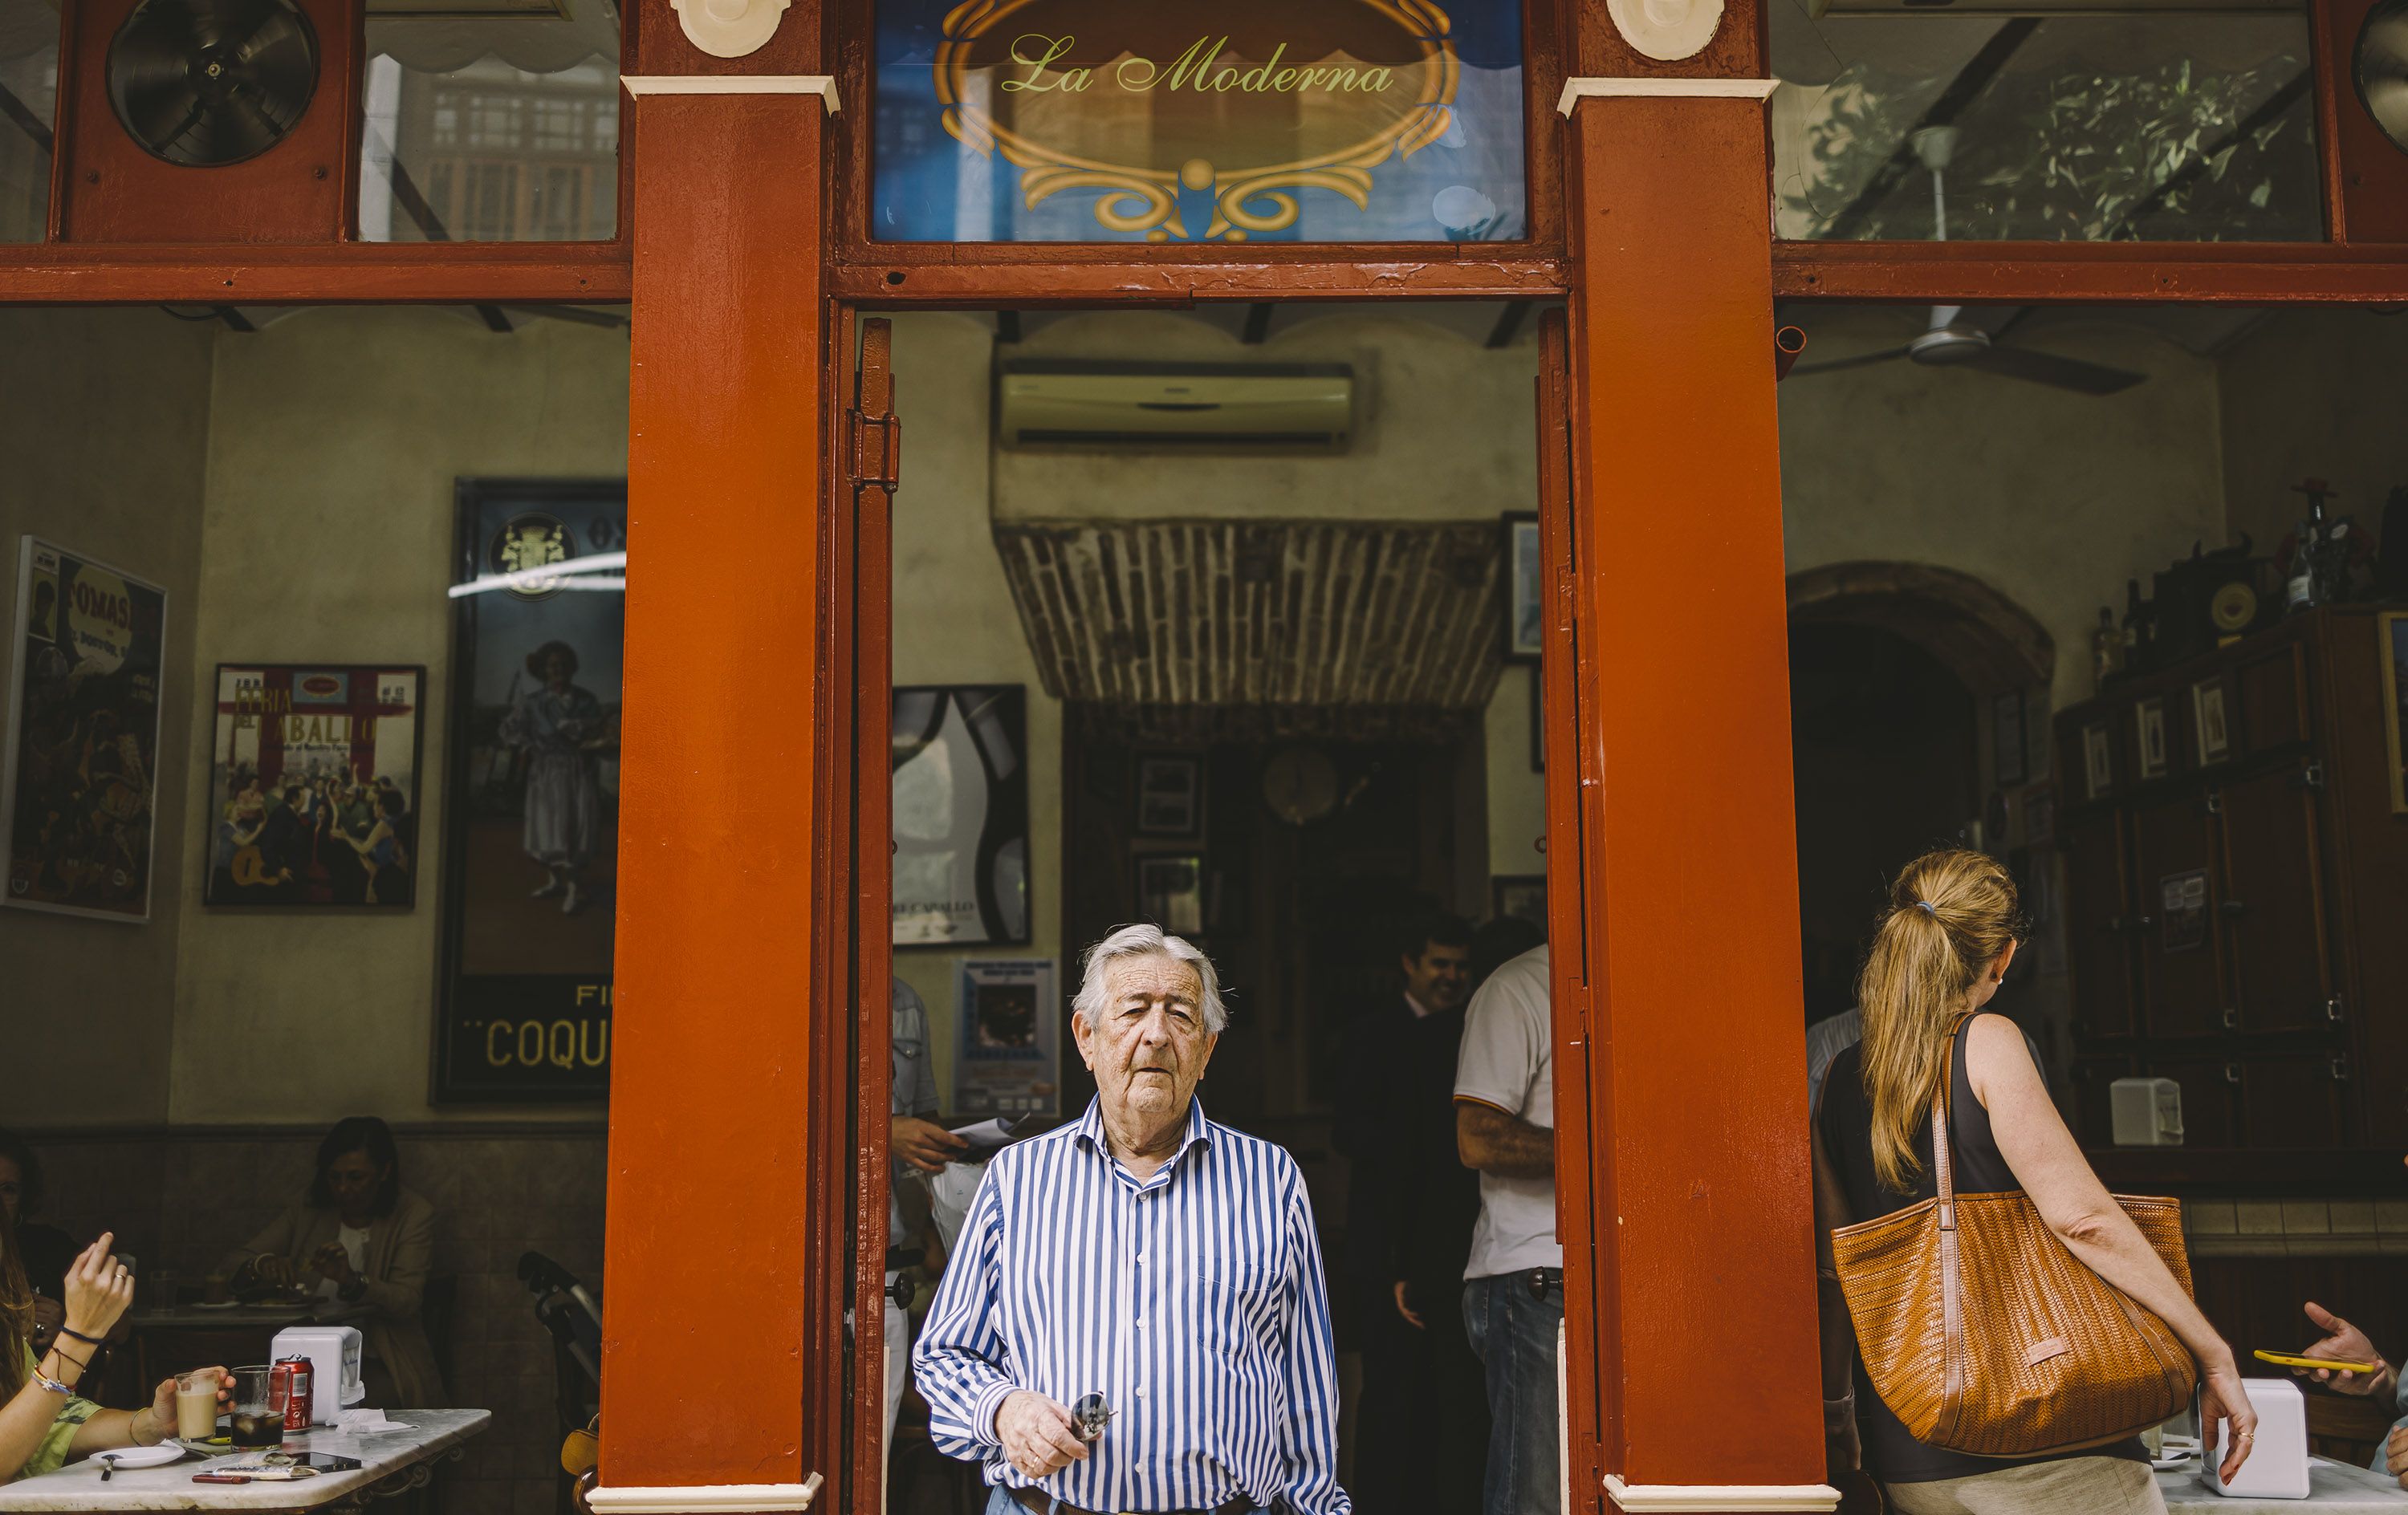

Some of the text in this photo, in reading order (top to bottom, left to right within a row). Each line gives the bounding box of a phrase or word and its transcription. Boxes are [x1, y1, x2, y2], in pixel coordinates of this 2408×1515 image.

[1001, 34, 1394, 92] La Moderna
[257, 714, 377, 743] CABALLO
